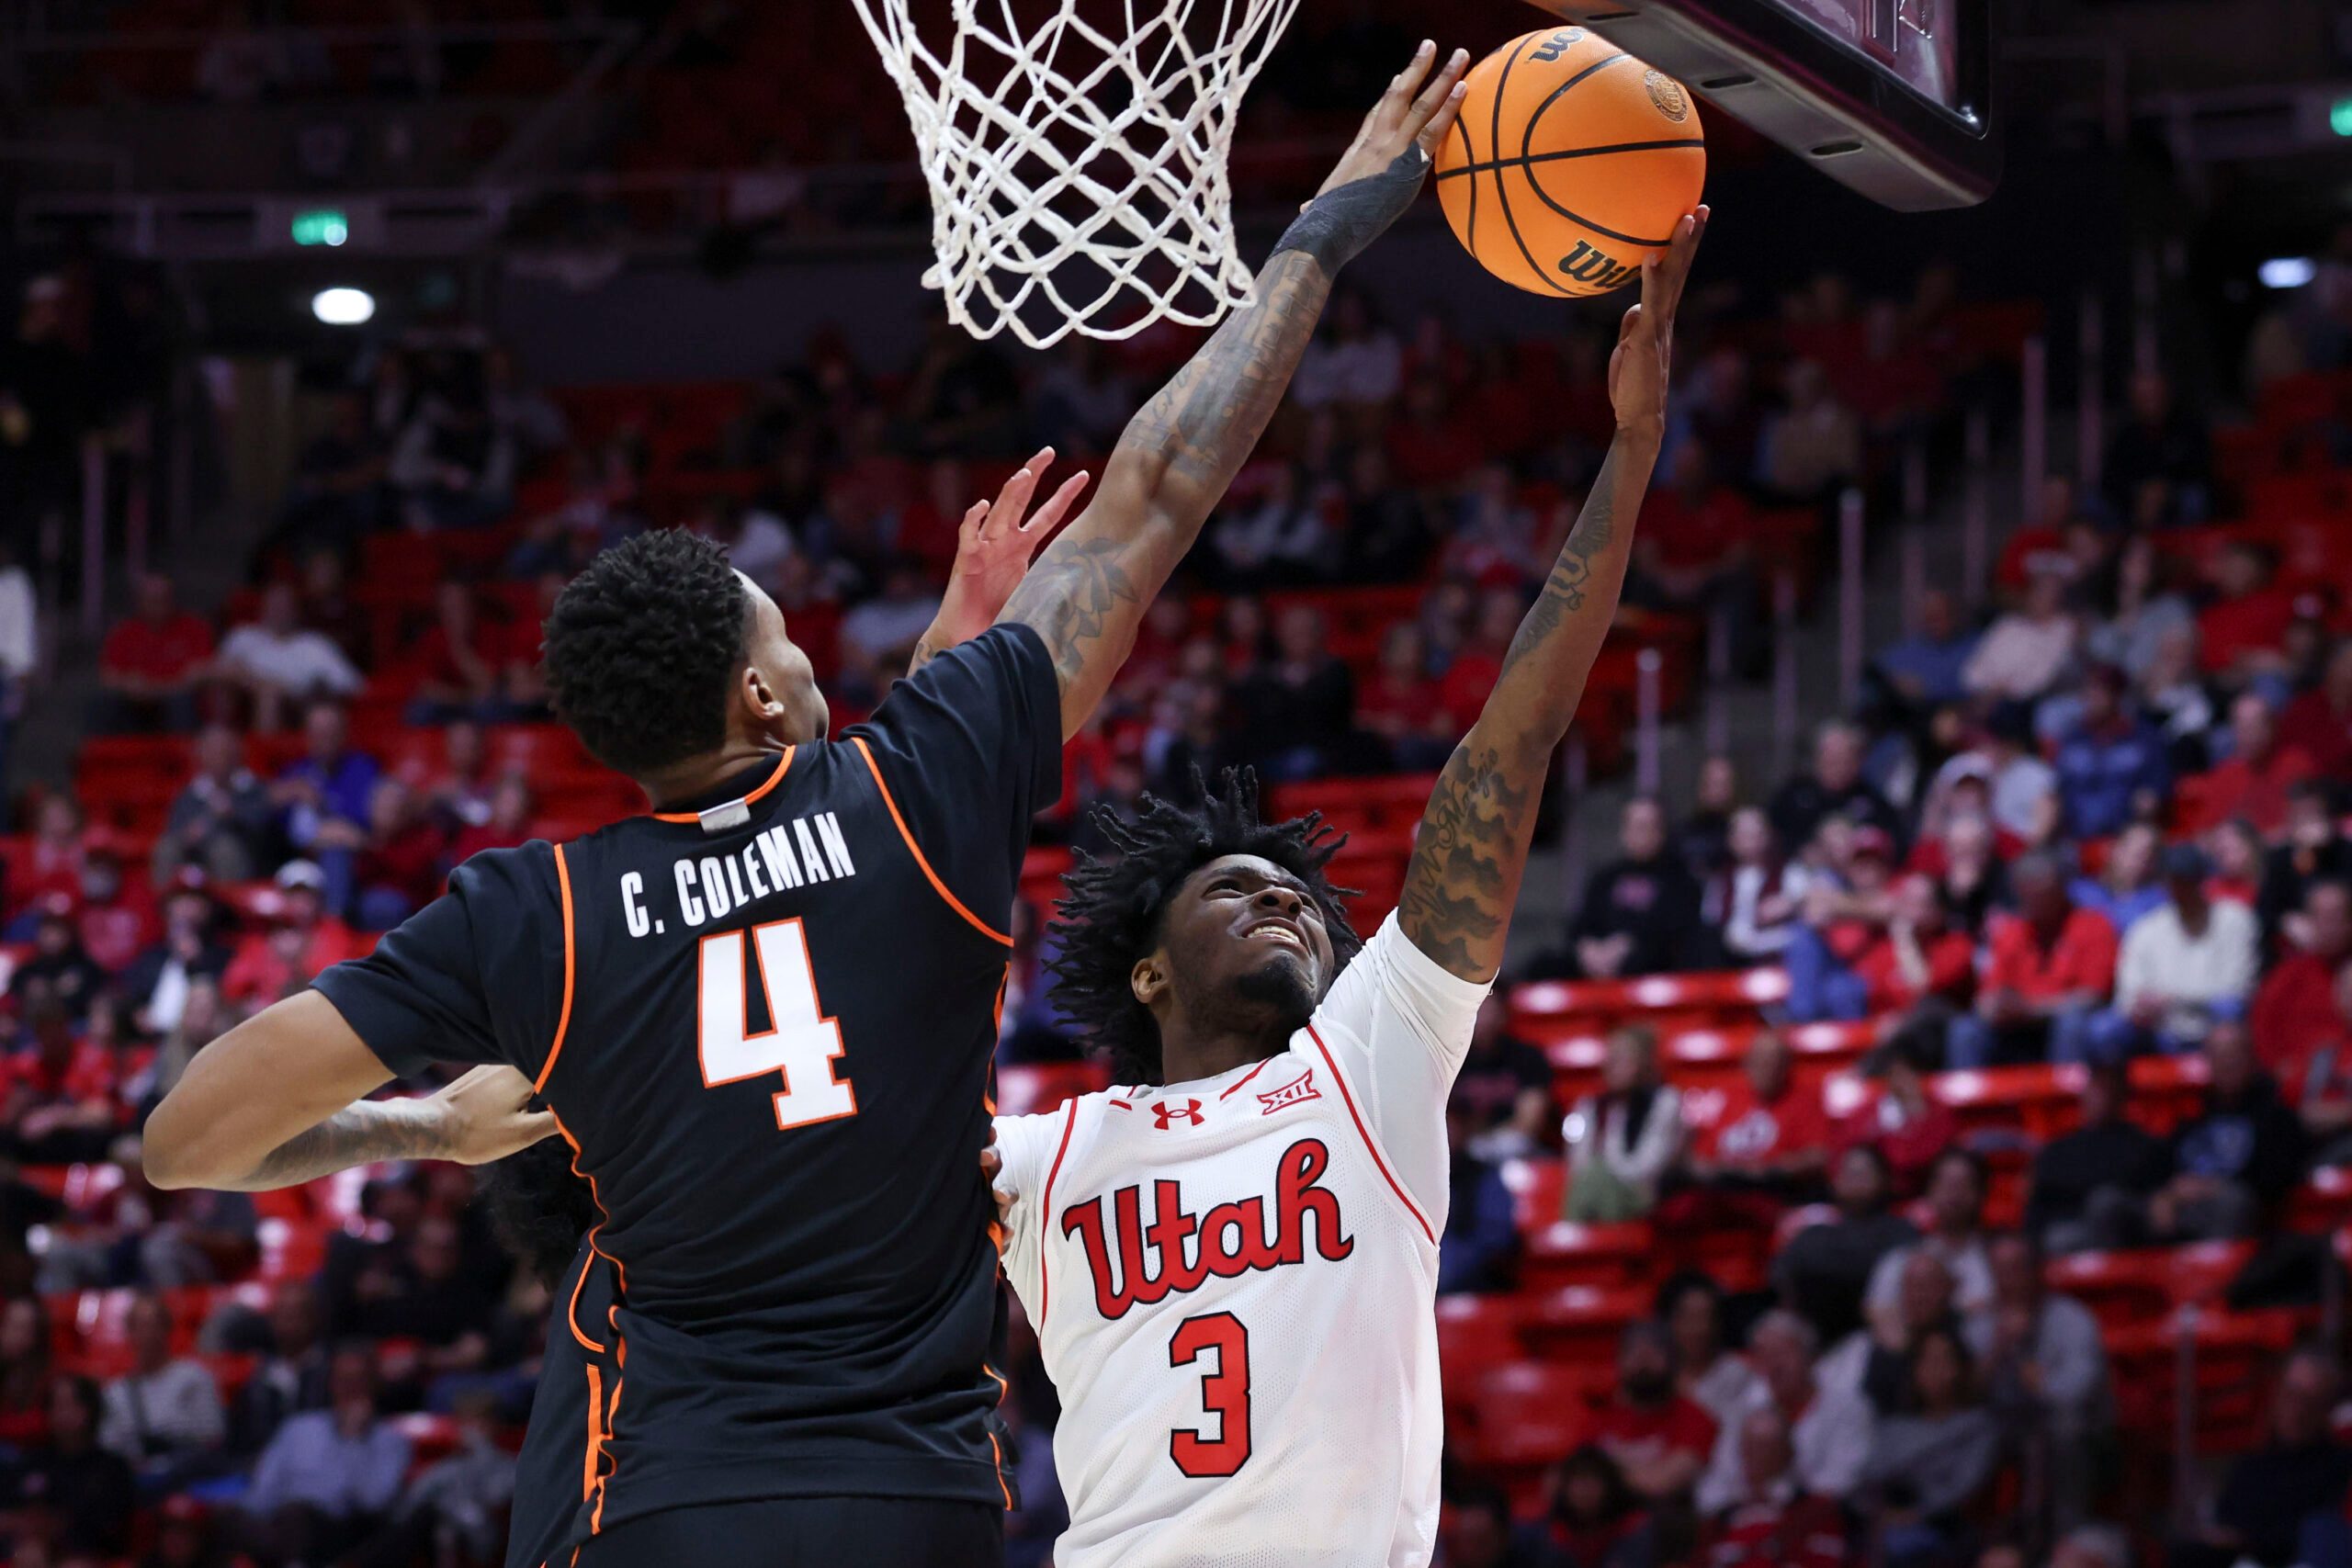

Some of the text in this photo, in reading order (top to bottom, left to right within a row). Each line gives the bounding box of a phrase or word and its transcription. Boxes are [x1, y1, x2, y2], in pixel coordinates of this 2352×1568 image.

[620, 811, 856, 938] C. COLEMAN
[697, 916, 858, 1131] 4
[1060, 1137, 1354, 1320] Utah
[1169, 1311, 1252, 1479] 3
